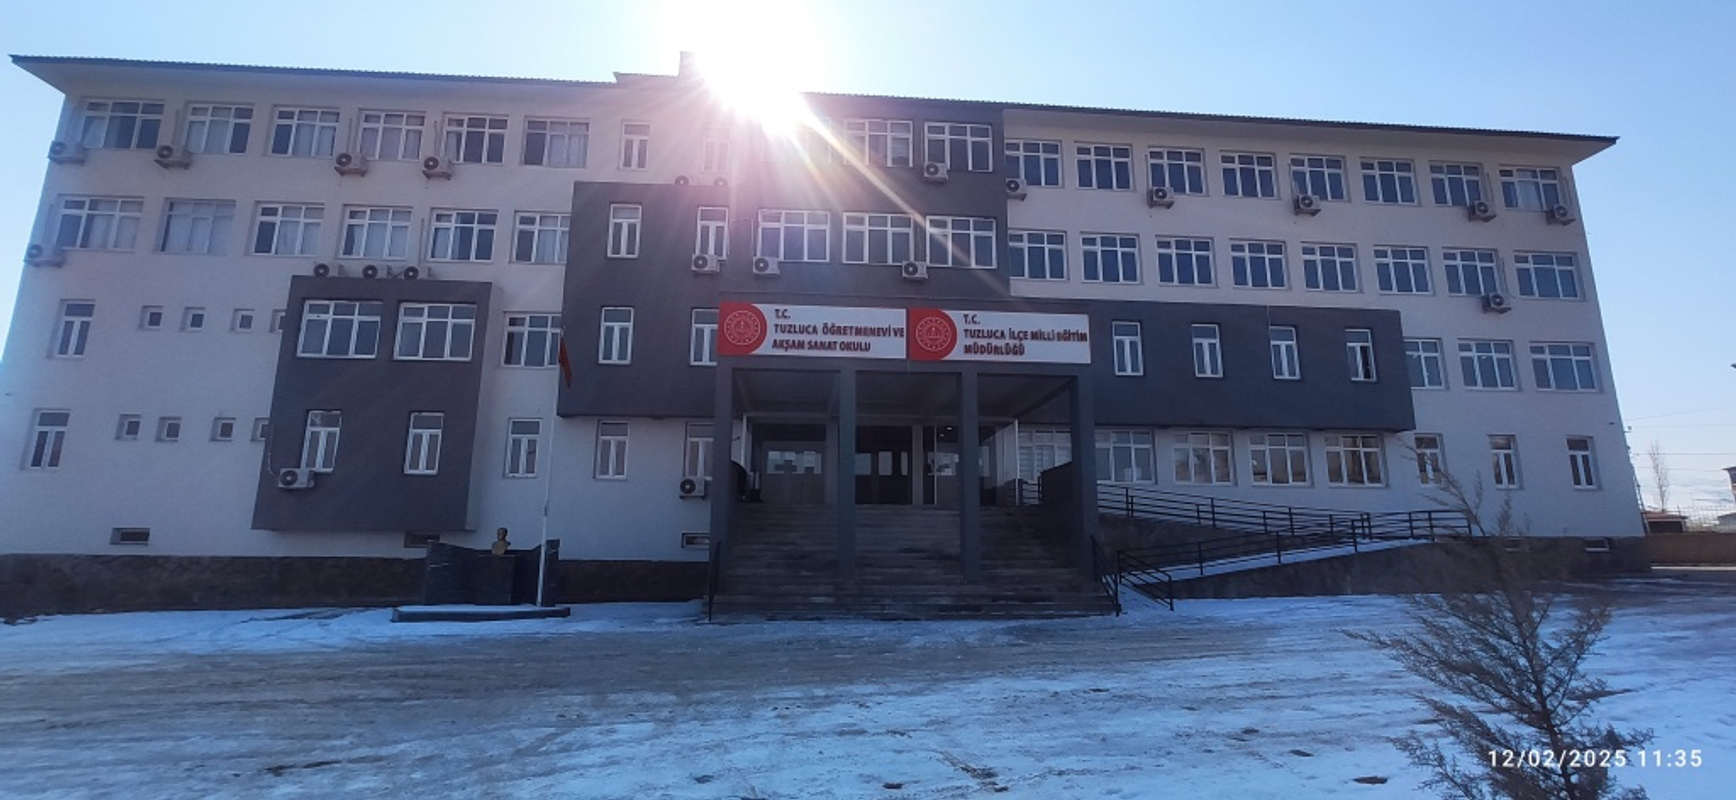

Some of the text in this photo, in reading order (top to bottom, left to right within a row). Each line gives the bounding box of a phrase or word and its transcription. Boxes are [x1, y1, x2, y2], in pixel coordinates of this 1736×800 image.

[774, 308, 791, 319] T.C.
[963, 314, 981, 325] T.C.
[773, 322, 905, 337] TUZLUCA ÖĞRETMENEVİ VE
[963, 327, 1088, 342] TUZLUCA İLÇE MİLLİ EĞİTİM
[771, 338, 871, 352] AKŞAM SANAT OKULU
[963, 342, 1025, 356] MÜDÜRLÜĞÜ
